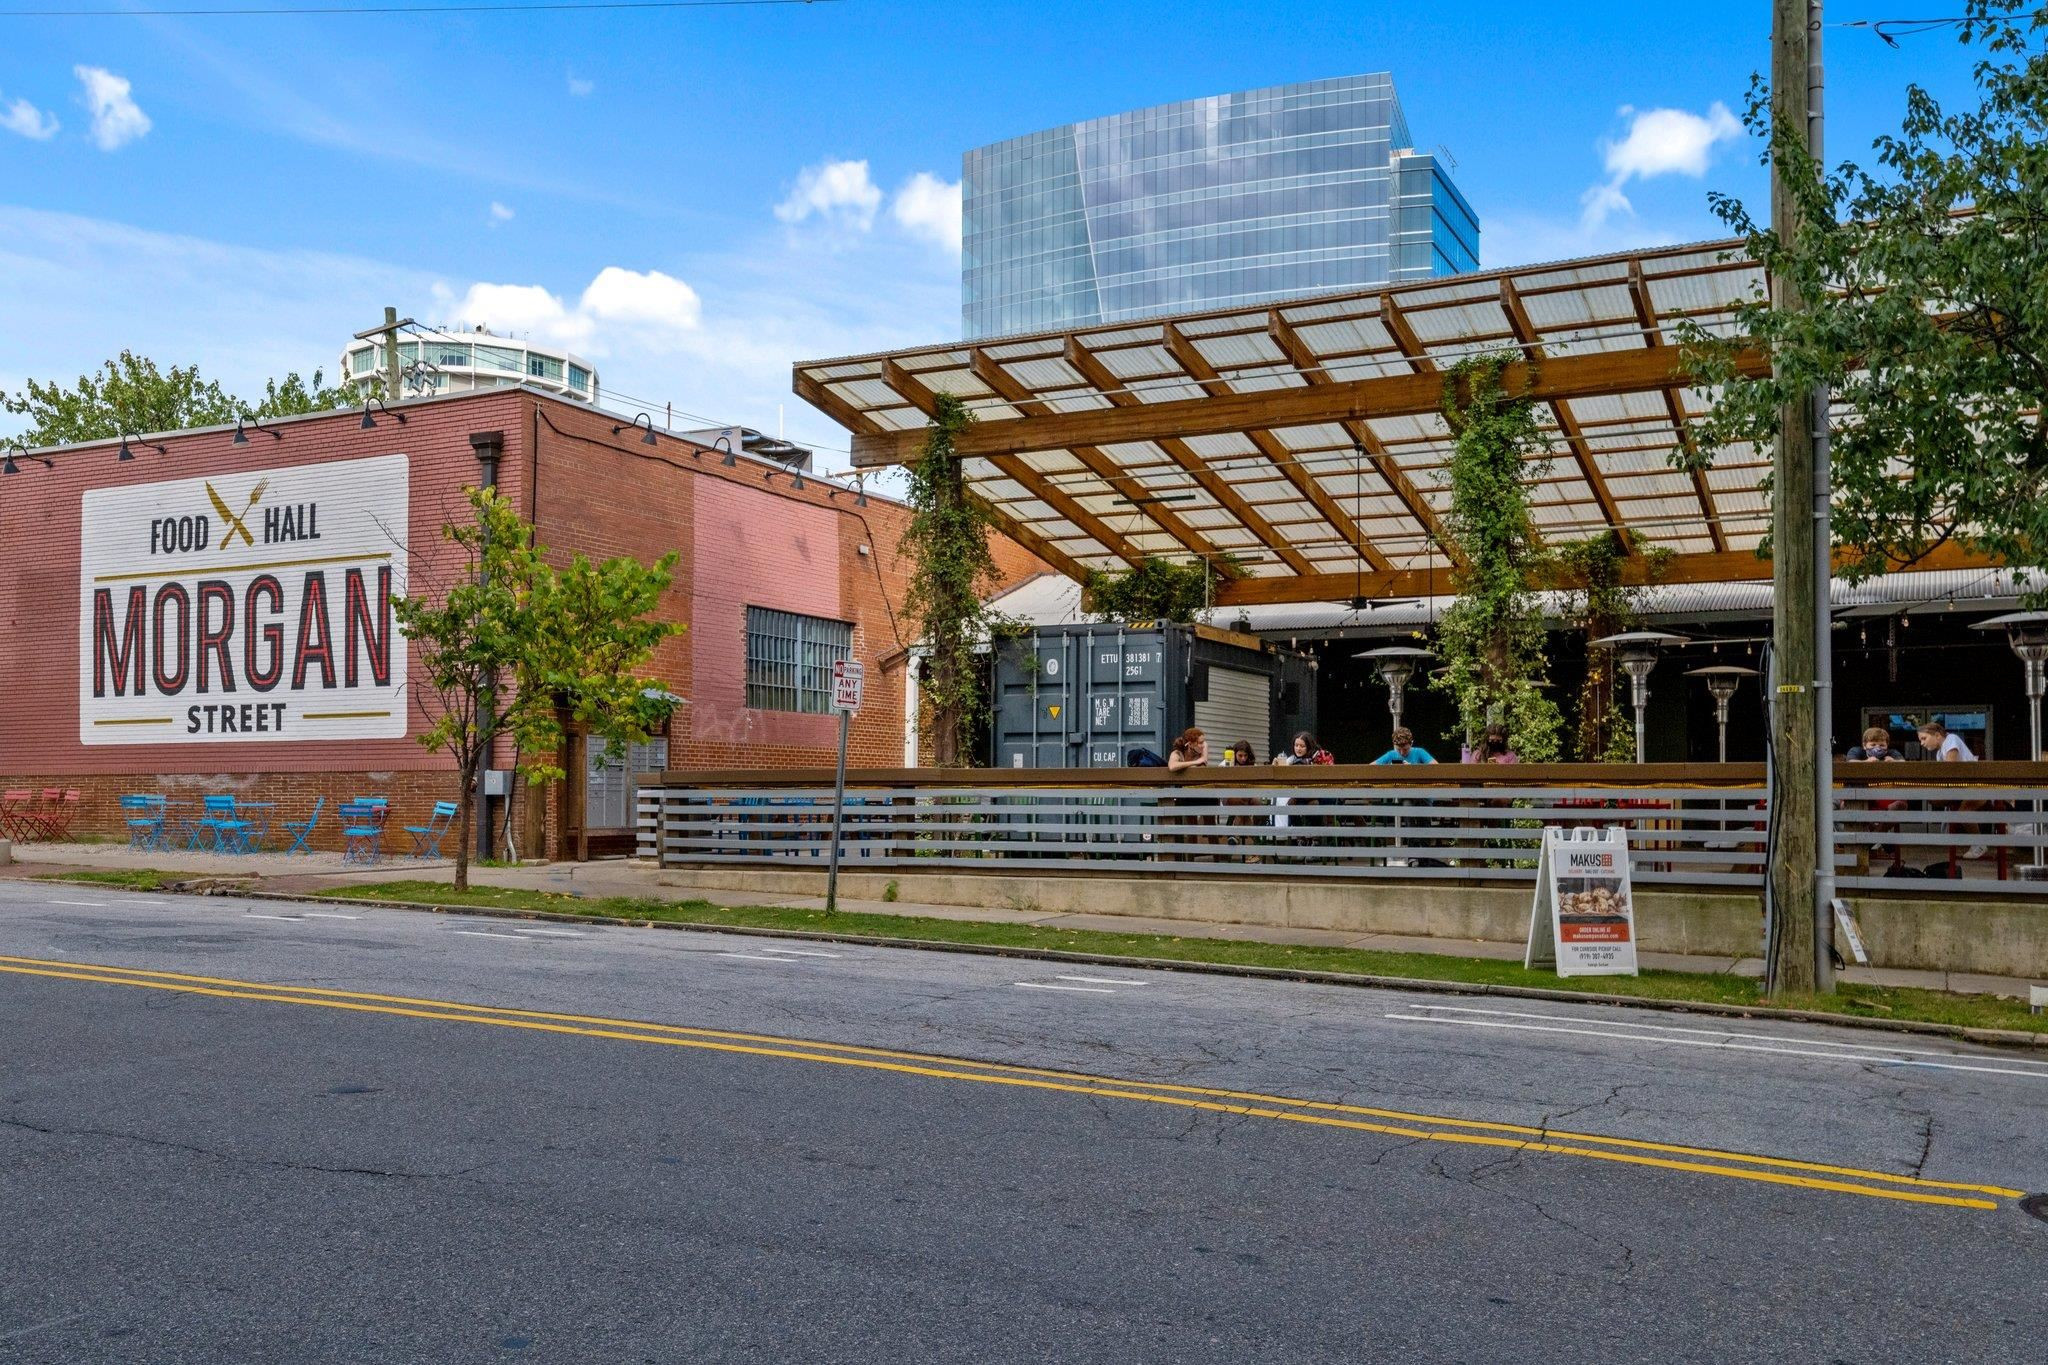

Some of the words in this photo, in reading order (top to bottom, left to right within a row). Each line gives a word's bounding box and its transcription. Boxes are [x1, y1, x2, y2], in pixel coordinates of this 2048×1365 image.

[151, 515, 209, 554] FOOD
[264, 503, 321, 544] HALL
[93, 565, 392, 698] MORGAN
[1101, 653, 1119, 664] ETTU
[1125, 652, 1151, 663] 381381
[835, 664, 844, 675] NO
[838, 678, 857, 688] ANY
[837, 689, 858, 700] TIME
[1096, 706, 1110, 717] TARE
[187, 702, 287, 734] STREET
[1095, 716, 1107, 726] NET
[1570, 853, 1601, 867] MAKUS
